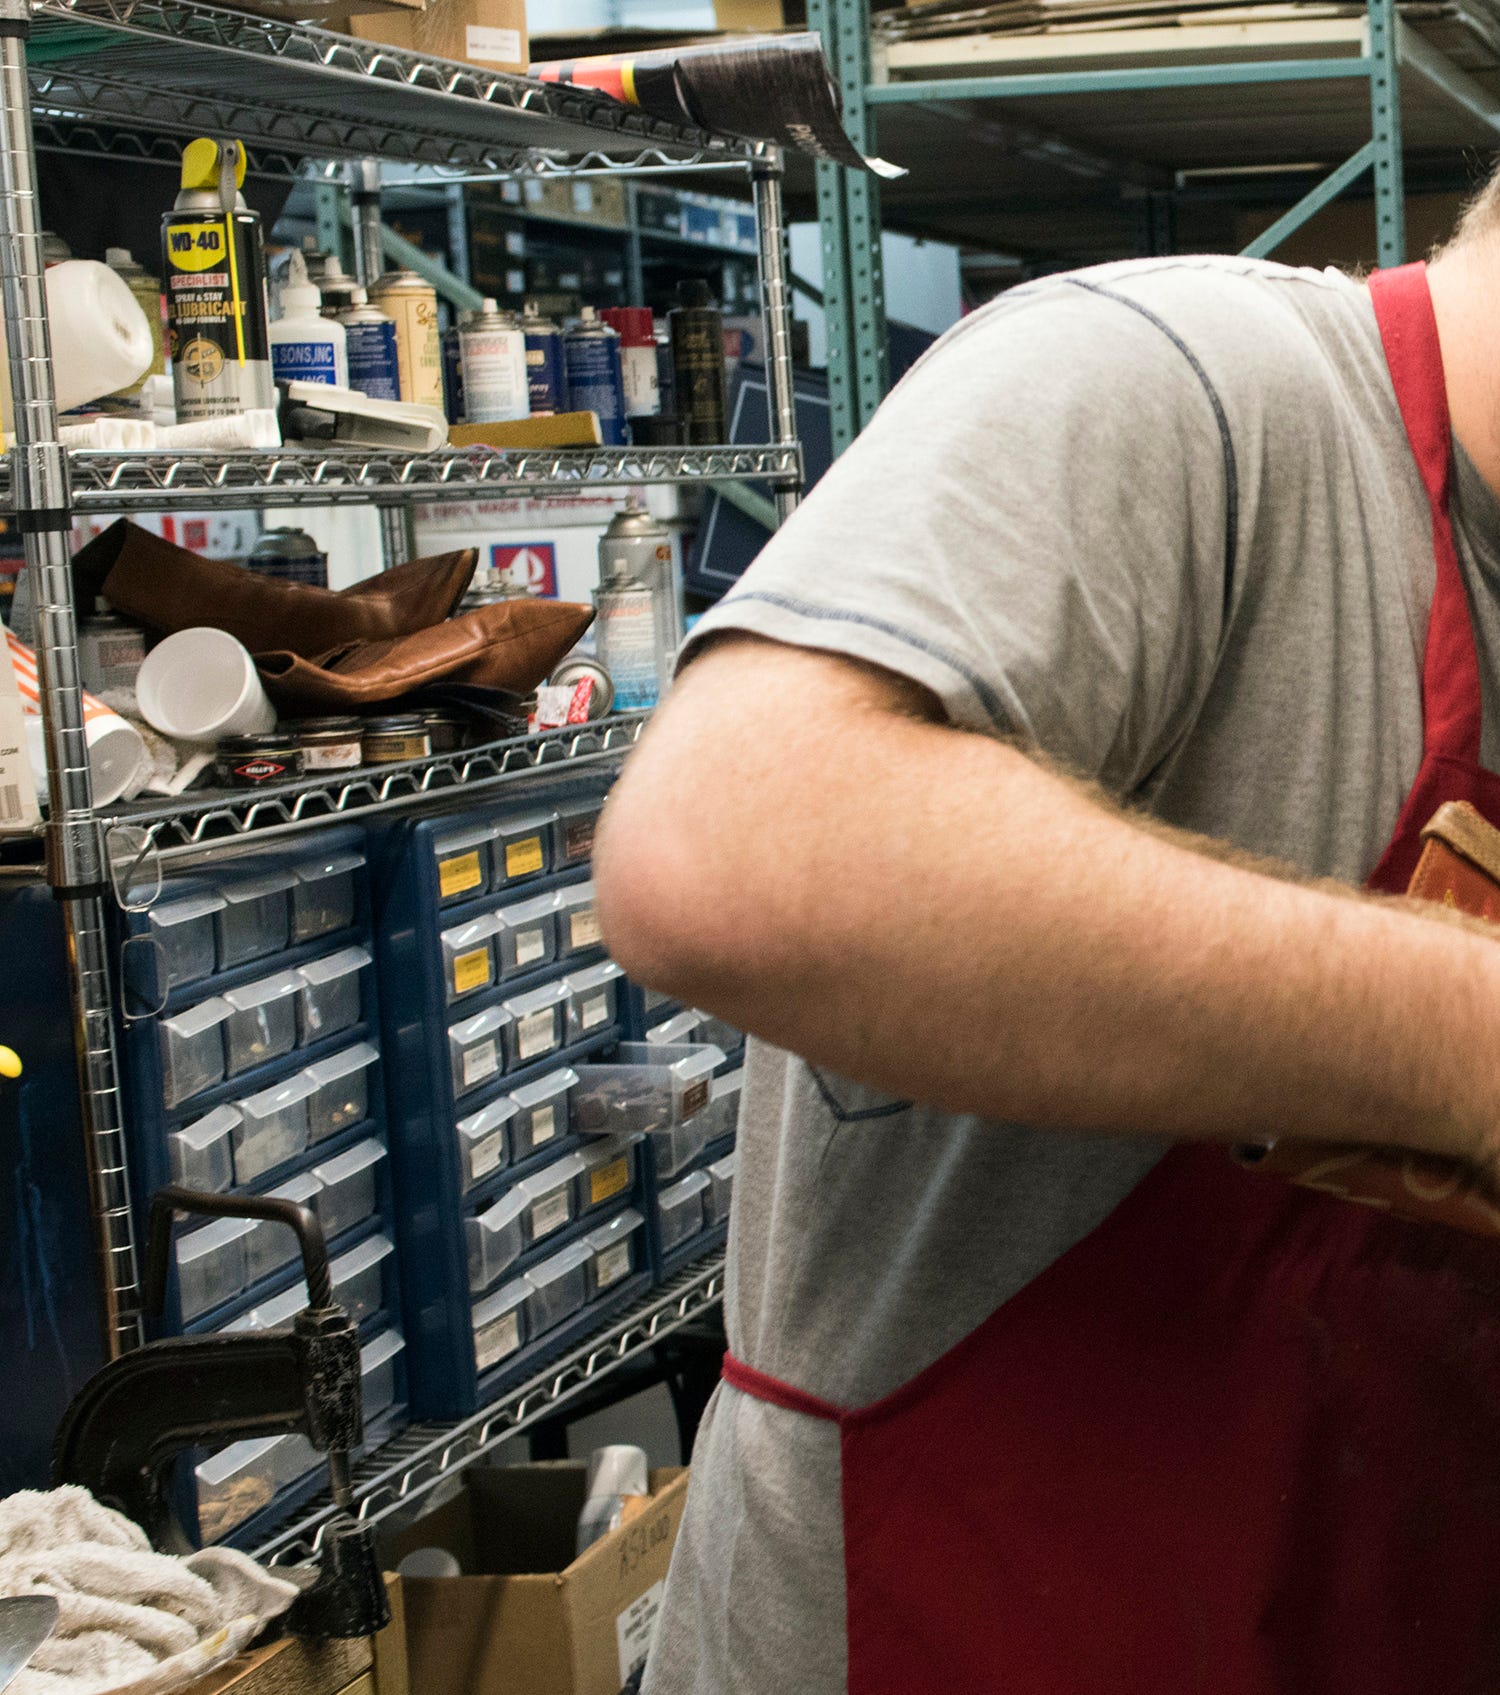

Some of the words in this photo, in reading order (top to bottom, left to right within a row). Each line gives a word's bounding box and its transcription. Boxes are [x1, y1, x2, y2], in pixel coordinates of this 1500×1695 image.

[170, 231, 220, 253] WD-40
[171, 274, 226, 288] SPECIALIST
[174, 293, 196, 304] SPRAY
[203, 291, 224, 302] STAY
[177, 300, 247, 318] LUBRICAT
[204, 396, 240, 405] LUBRICATION
[477, 501, 520, 515] MADE
